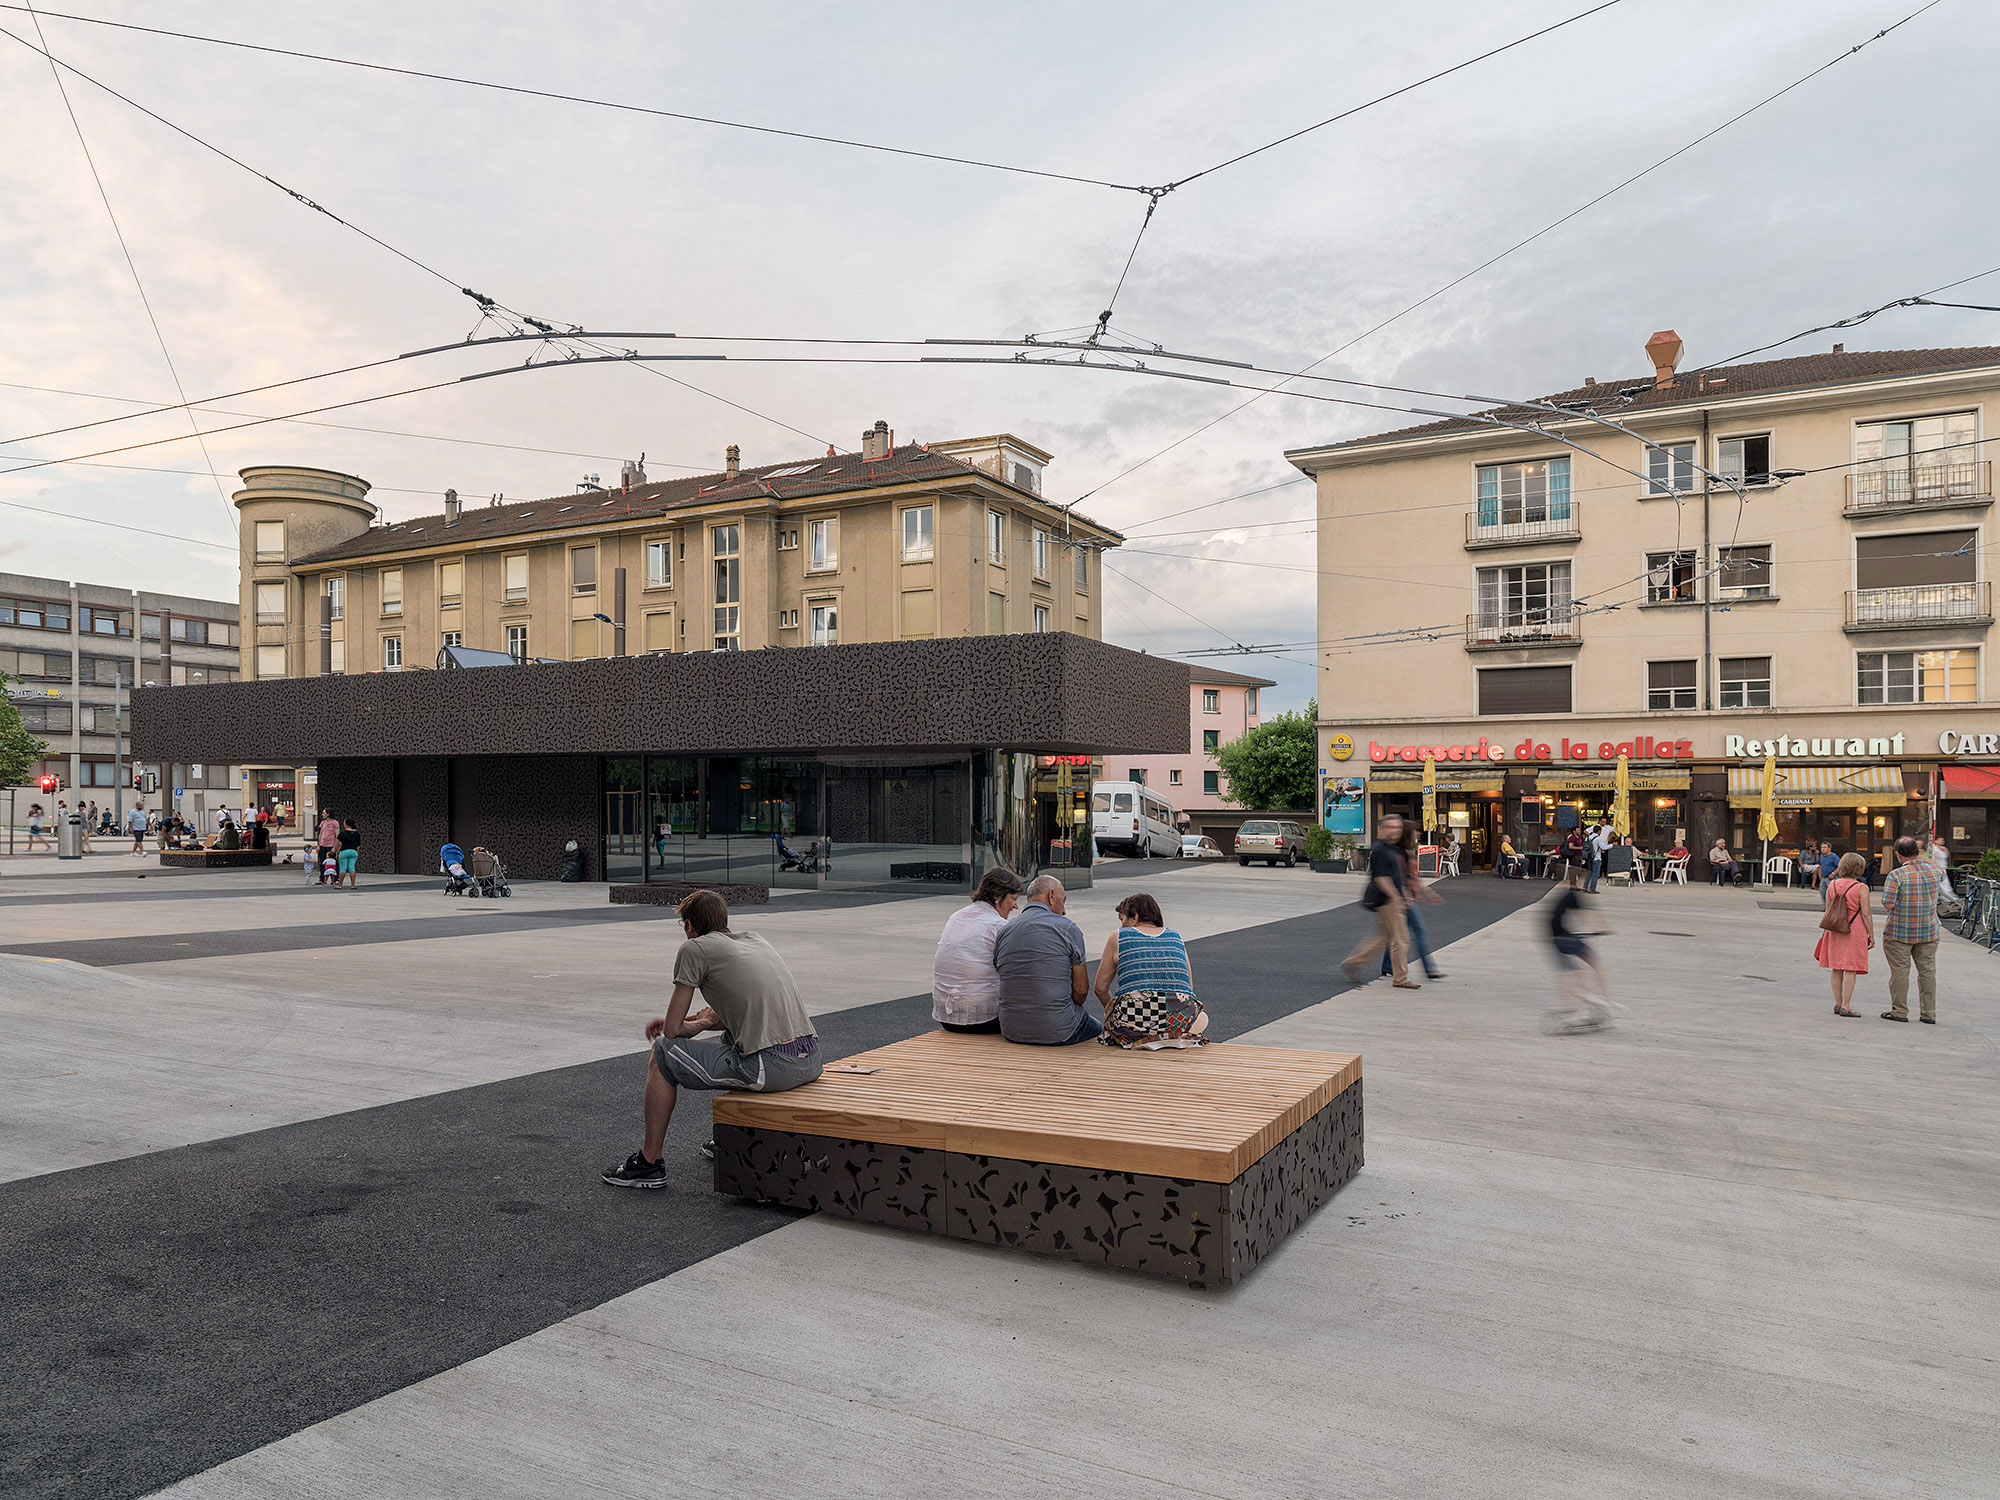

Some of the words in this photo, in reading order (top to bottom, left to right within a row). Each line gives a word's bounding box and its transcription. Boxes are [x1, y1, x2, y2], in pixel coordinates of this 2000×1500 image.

[1369, 736, 1505, 762] brasserie
[1514, 738, 1551, 760] de
[1562, 738, 1588, 760] la
[1598, 736, 1694, 760] sallaz
[1726, 731, 1905, 757] Restaurant
[1939, 730, 2000, 755] CAR
[1565, 781, 1606, 789] Brasserie
